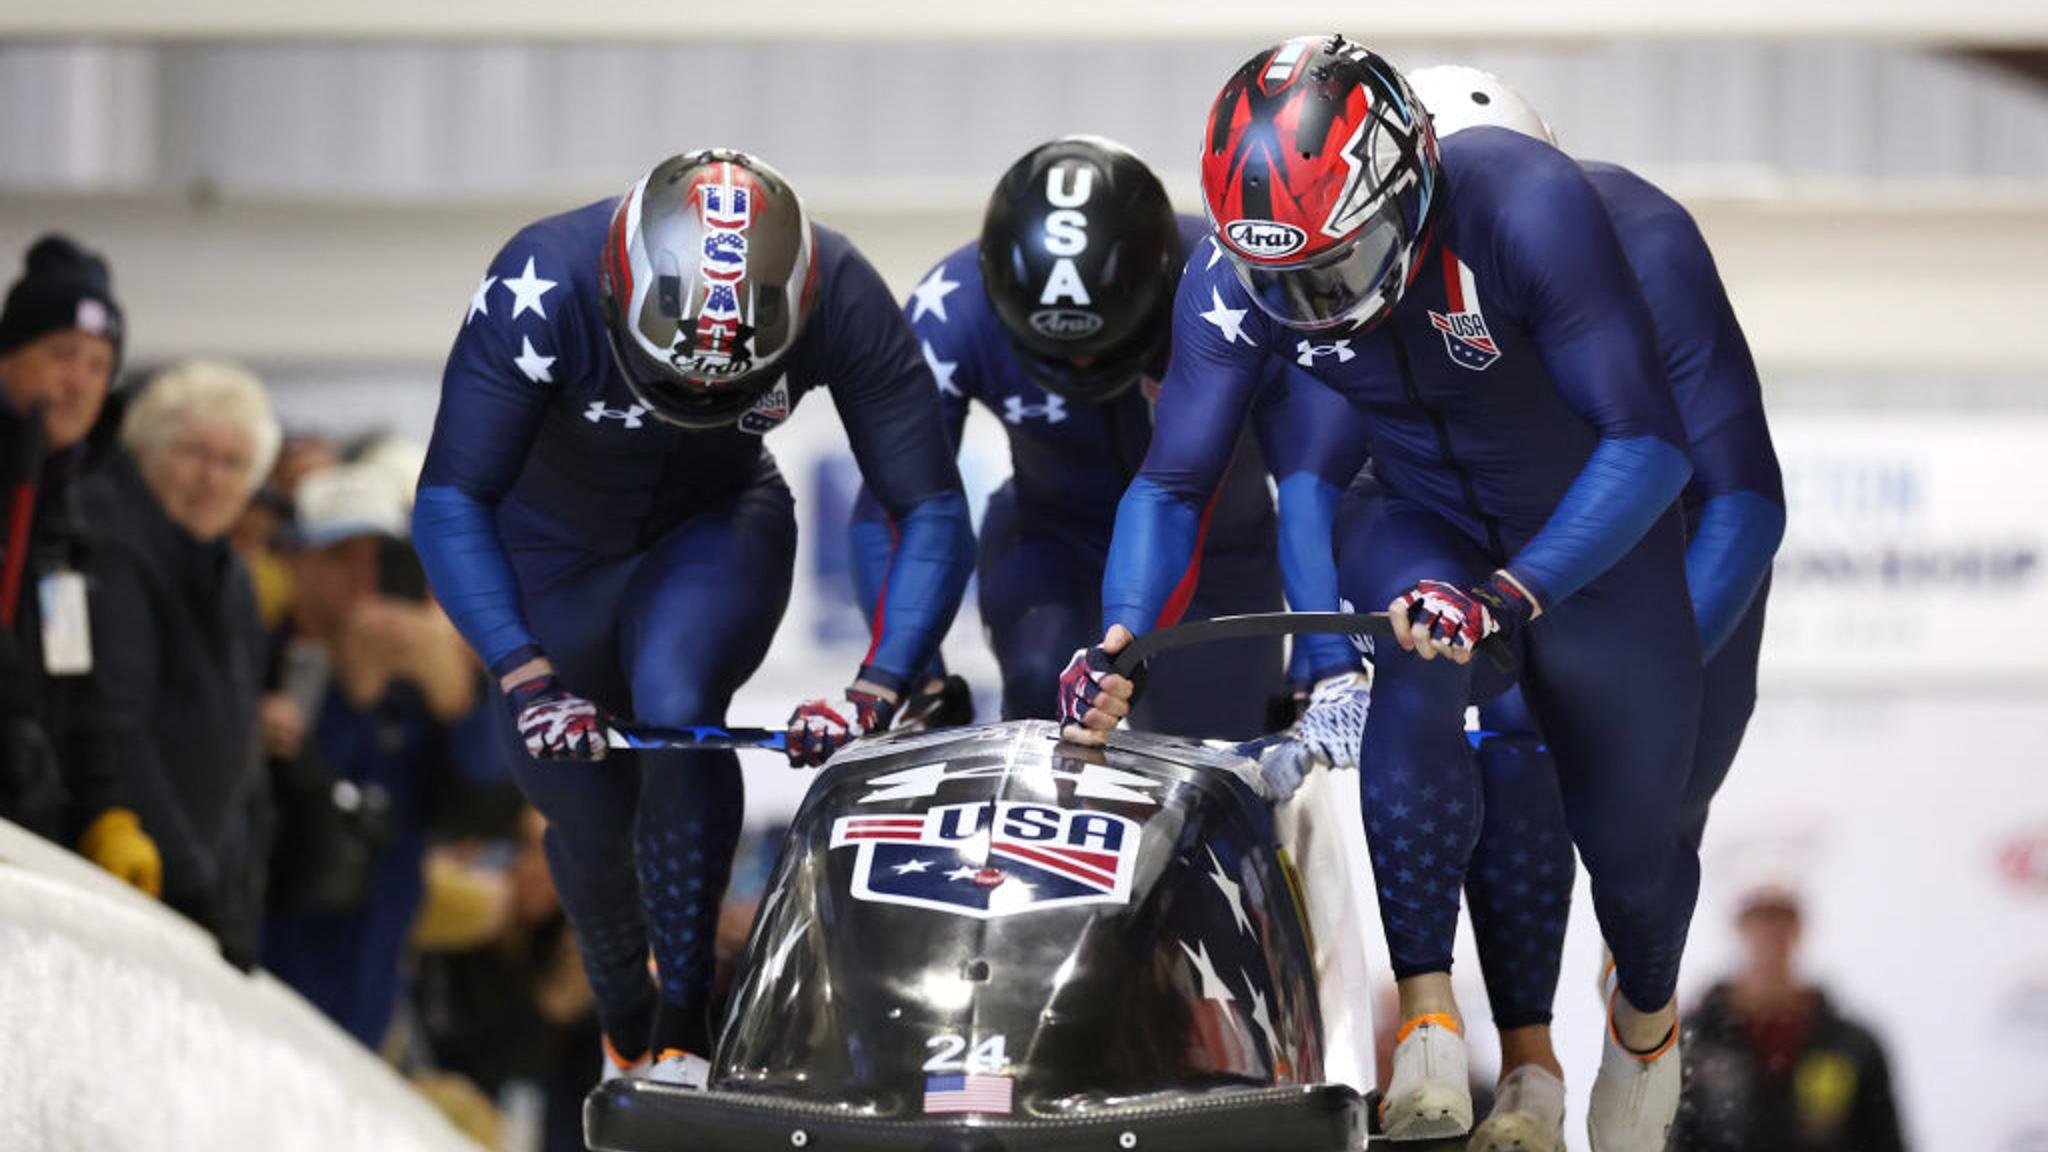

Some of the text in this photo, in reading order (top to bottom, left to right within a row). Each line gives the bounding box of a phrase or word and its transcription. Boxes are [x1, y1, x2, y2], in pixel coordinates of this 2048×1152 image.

[1040, 167, 1093, 305] USA
[1231, 222, 1293, 247] Arai
[1451, 313, 1486, 337] USA
[939, 806, 1125, 851] USA
[922, 1034, 1011, 1074] 24
